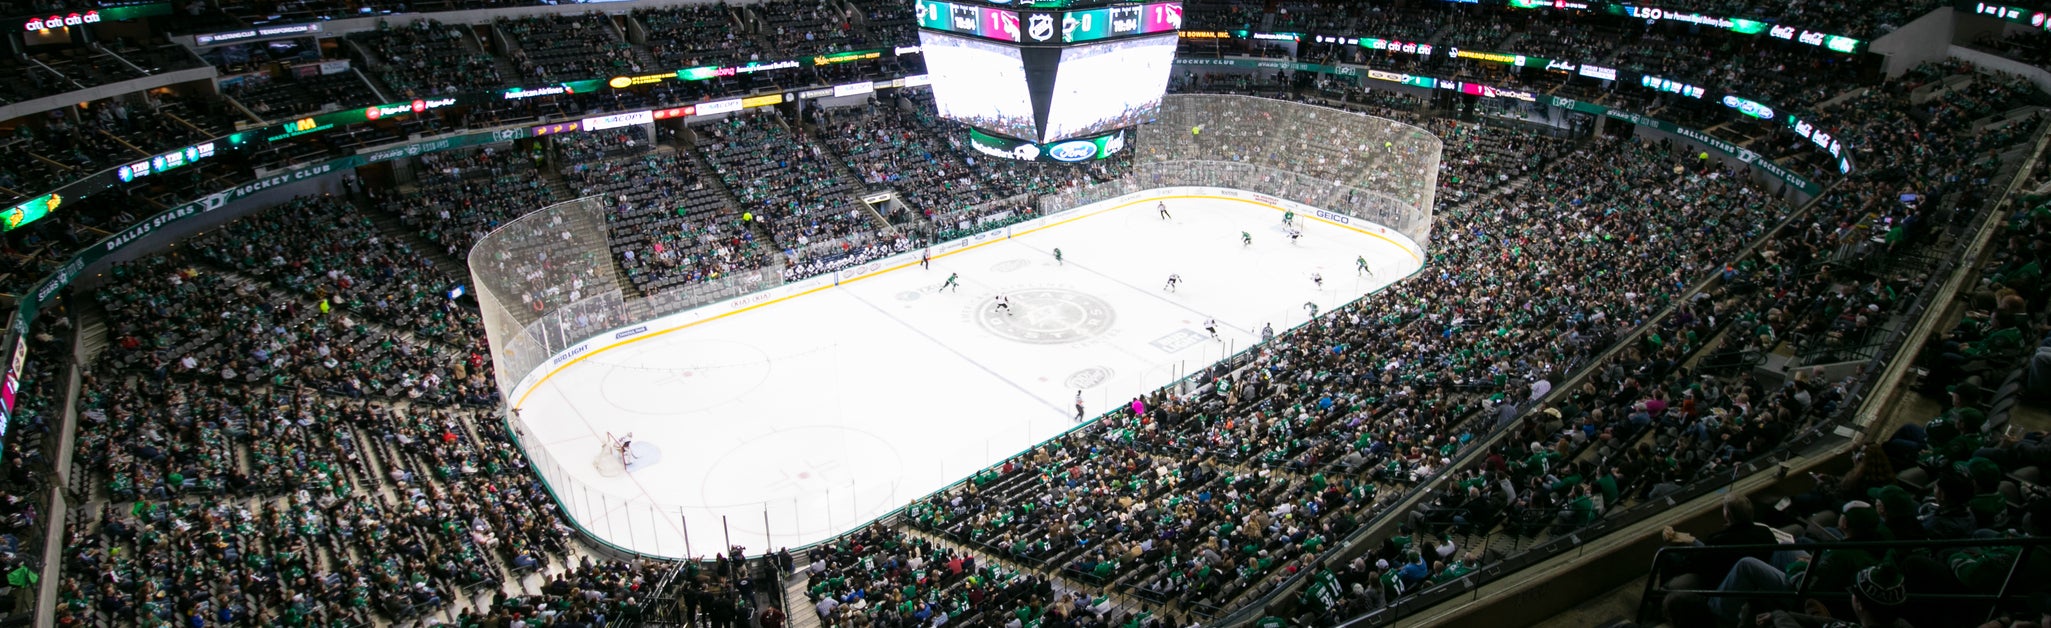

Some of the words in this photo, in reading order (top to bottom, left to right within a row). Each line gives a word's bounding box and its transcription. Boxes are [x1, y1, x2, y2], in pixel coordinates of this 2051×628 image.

[83, 12, 101, 24] citi
[929, 3, 938, 21] 0
[1155, 7, 1162, 24] 1
[1633, 6, 1663, 20] LSO
[25, 19, 44, 31] citi
[45, 16, 64, 28] citi
[65, 14, 83, 26] citi
[991, 12, 999, 30] 1
[1081, 13, 1092, 32] 0
[1253, 32, 1276, 40] American
[504, 89, 537, 100] American
[537, 86, 564, 96] Airlines
[267, 132, 290, 142] WASTE
[291, 123, 334, 137] MANAGEMENT
[197, 142, 214, 153] TXU
[165, 151, 183, 163] TXU
[369, 150, 404, 162] STARS
[1677, 127, 1708, 143] DALLAS
[1710, 138, 1735, 154] STARS
[1758, 158, 1786, 178] HOCKEY
[1786, 172, 1807, 189] CLUB
[131, 161, 150, 174] TXU
[106, 223, 151, 251] DALLAS
[153, 205, 195, 228] STARS
[236, 174, 290, 197] HOCKEY
[295, 164, 331, 179] CLUB
[1316, 209, 1350, 225] GEICO
[553, 352, 567, 365] BUD
[567, 343, 588, 358] LIGHT
[1329, 578, 1343, 598] 14
